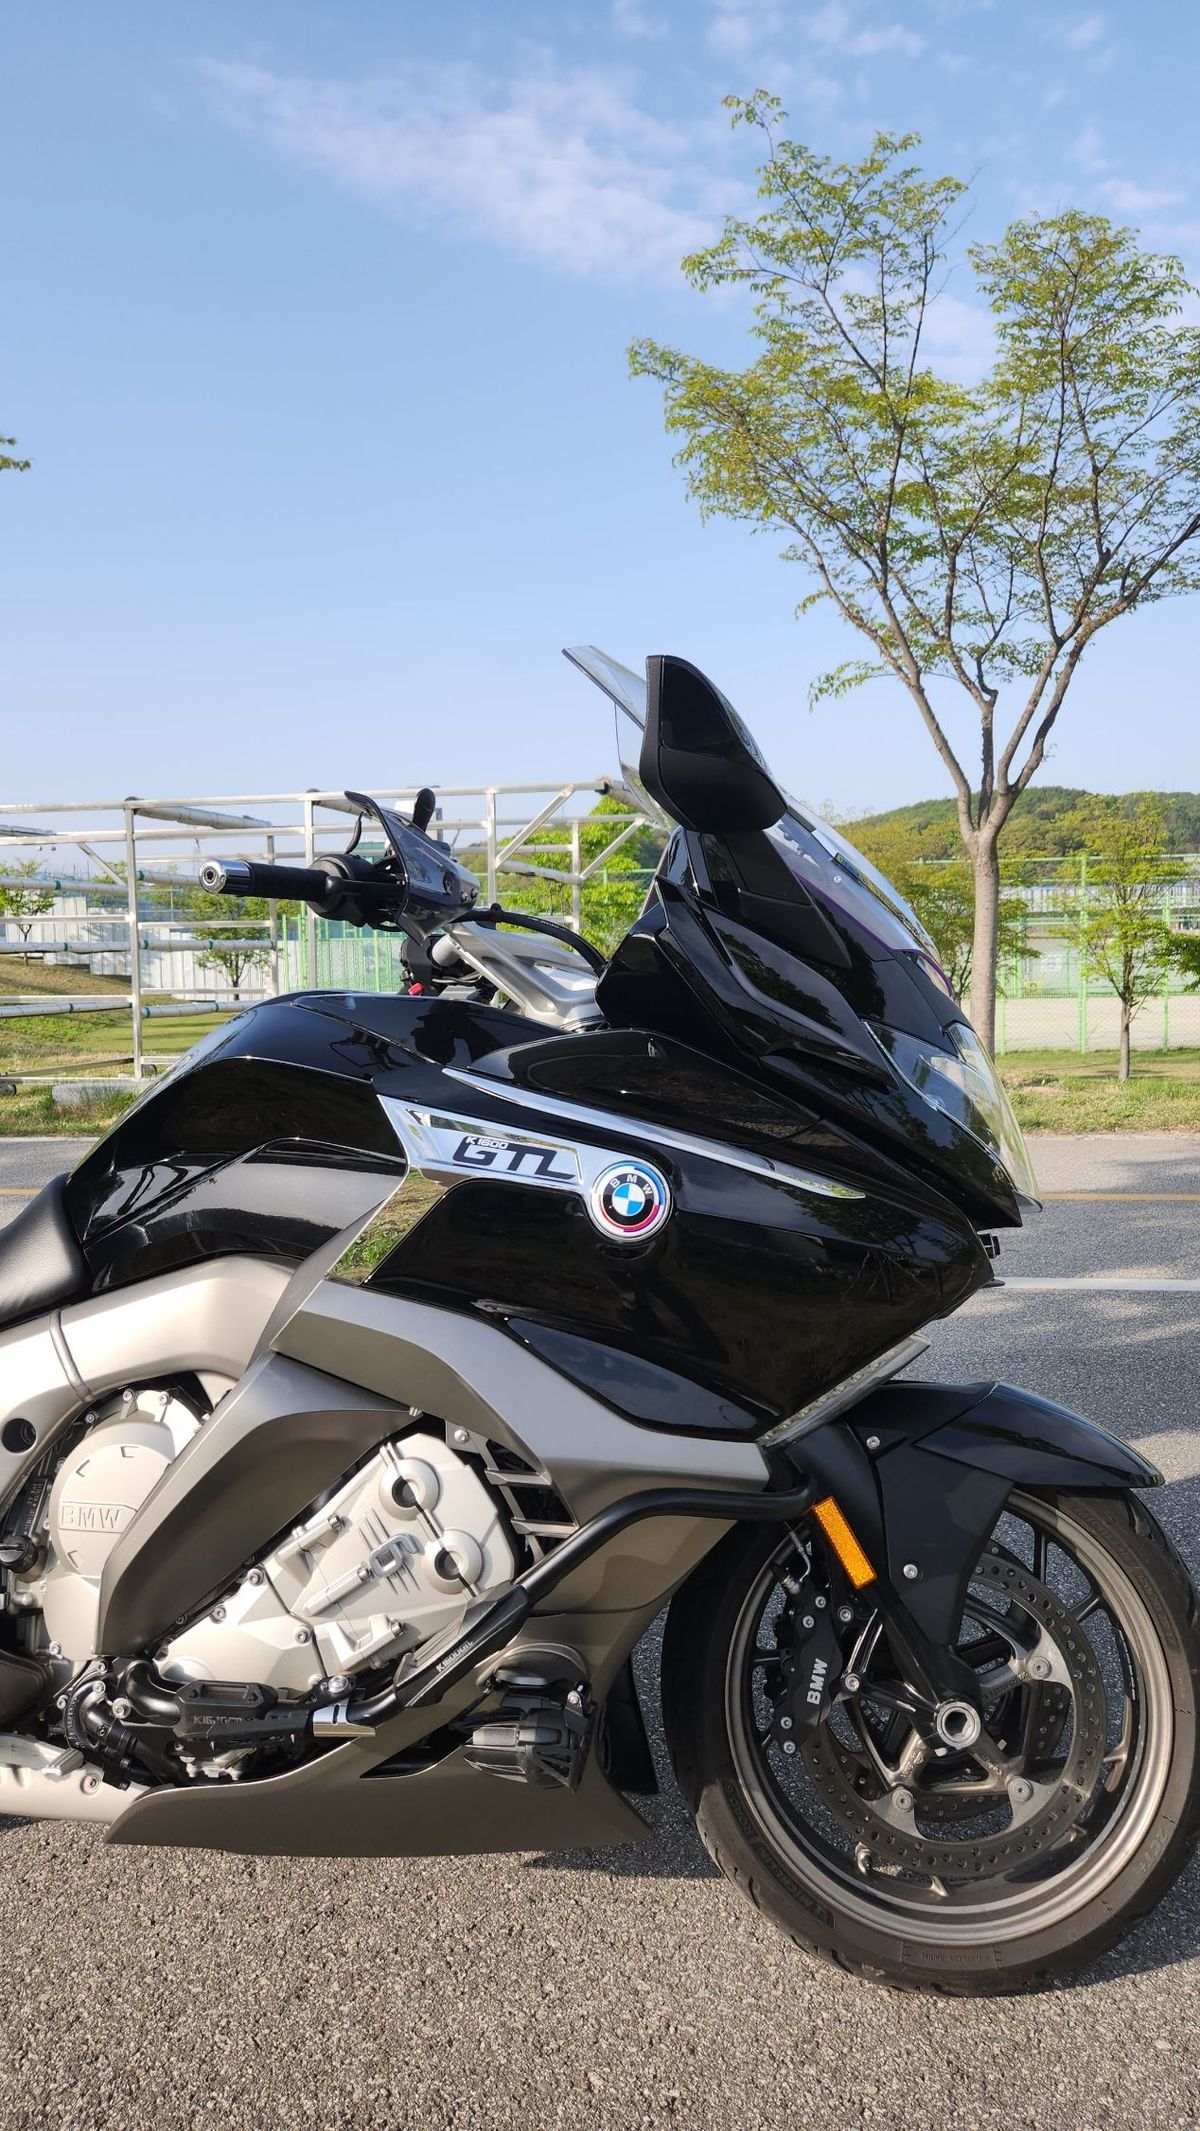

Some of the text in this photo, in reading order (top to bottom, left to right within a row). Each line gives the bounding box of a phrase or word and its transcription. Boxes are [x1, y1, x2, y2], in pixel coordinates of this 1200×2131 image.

[452, 1135, 577, 1180] GTL
[609, 1173, 653, 1196] BMW
[61, 1504, 121, 1530] BMW
[806, 1657, 828, 1705] BMW
